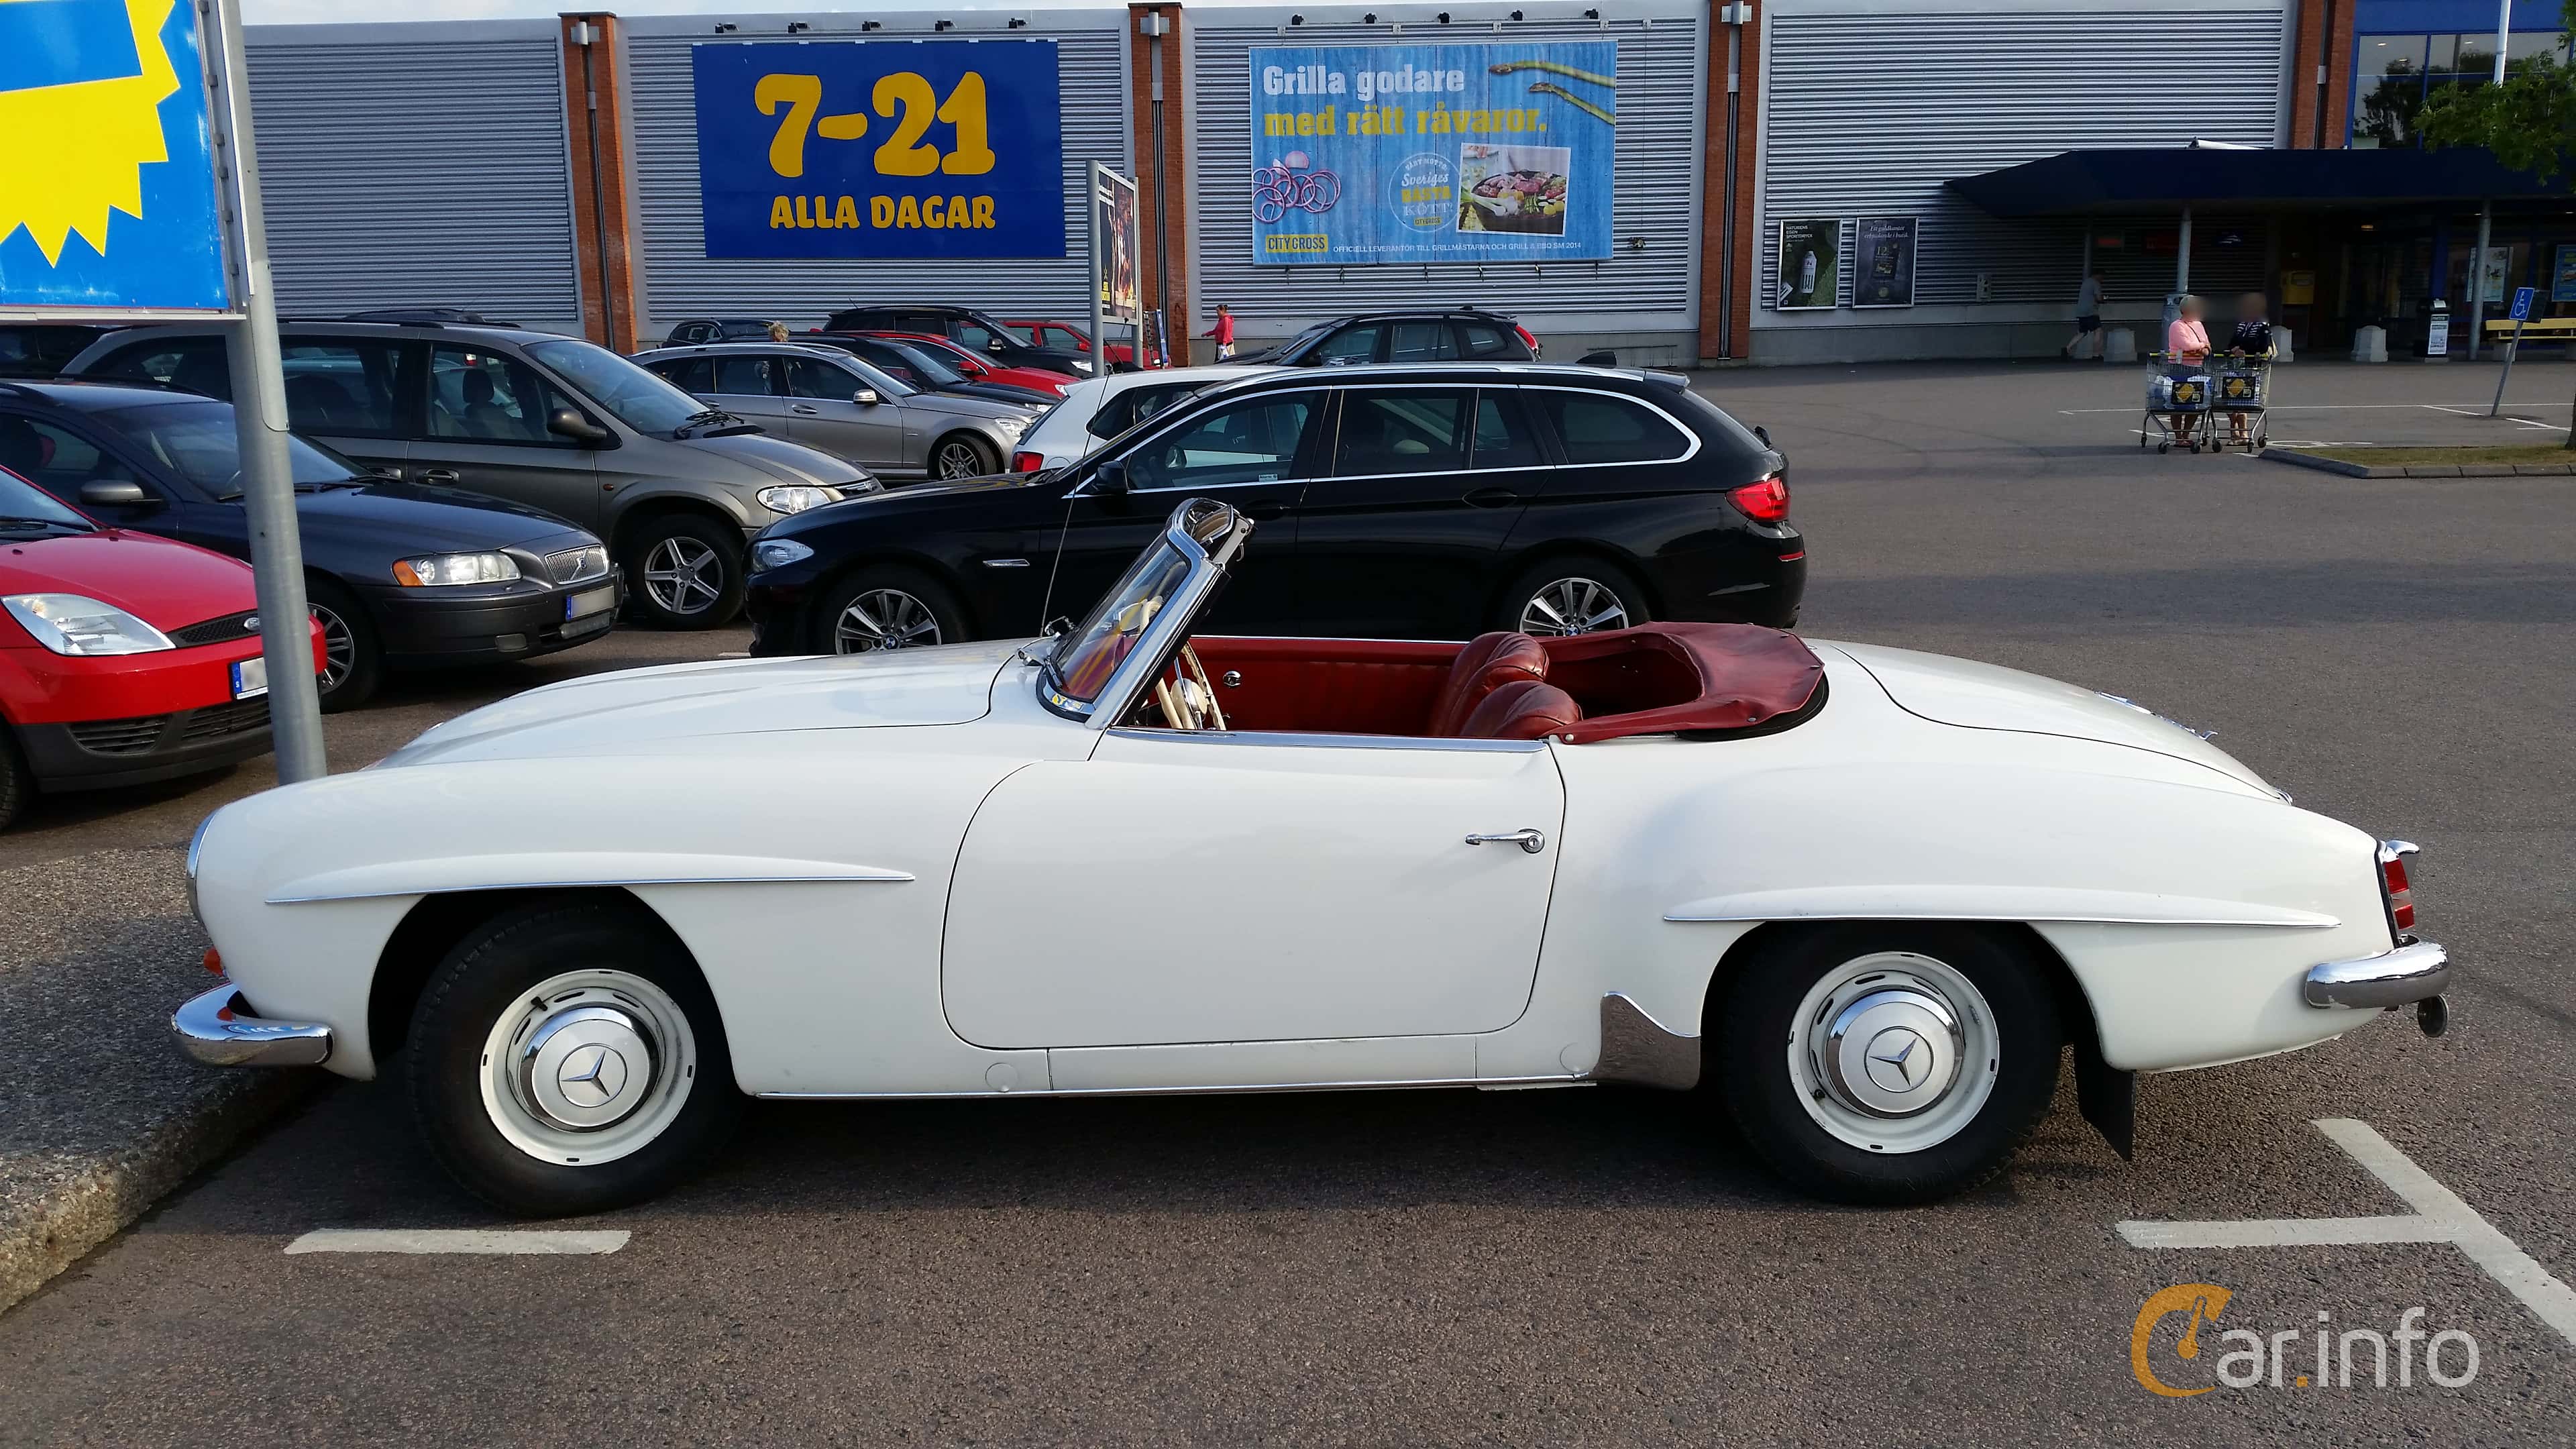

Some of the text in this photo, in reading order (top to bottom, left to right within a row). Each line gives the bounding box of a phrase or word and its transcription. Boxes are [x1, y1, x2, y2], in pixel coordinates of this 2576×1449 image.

[1263, 64, 1465, 101] Grilla godare
[754, 71, 996, 178] 7-21
[1264, 101, 1547, 136] med rätt råvaror.
[1401, 171, 1450, 187] Sveriges
[1401, 185, 1452, 203] BÄSTA
[769, 195, 996, 229] ALLA DAGAR
[1269, 237, 1326, 250] CITY GROSS
[1508, 242, 1529, 250] GRILL
